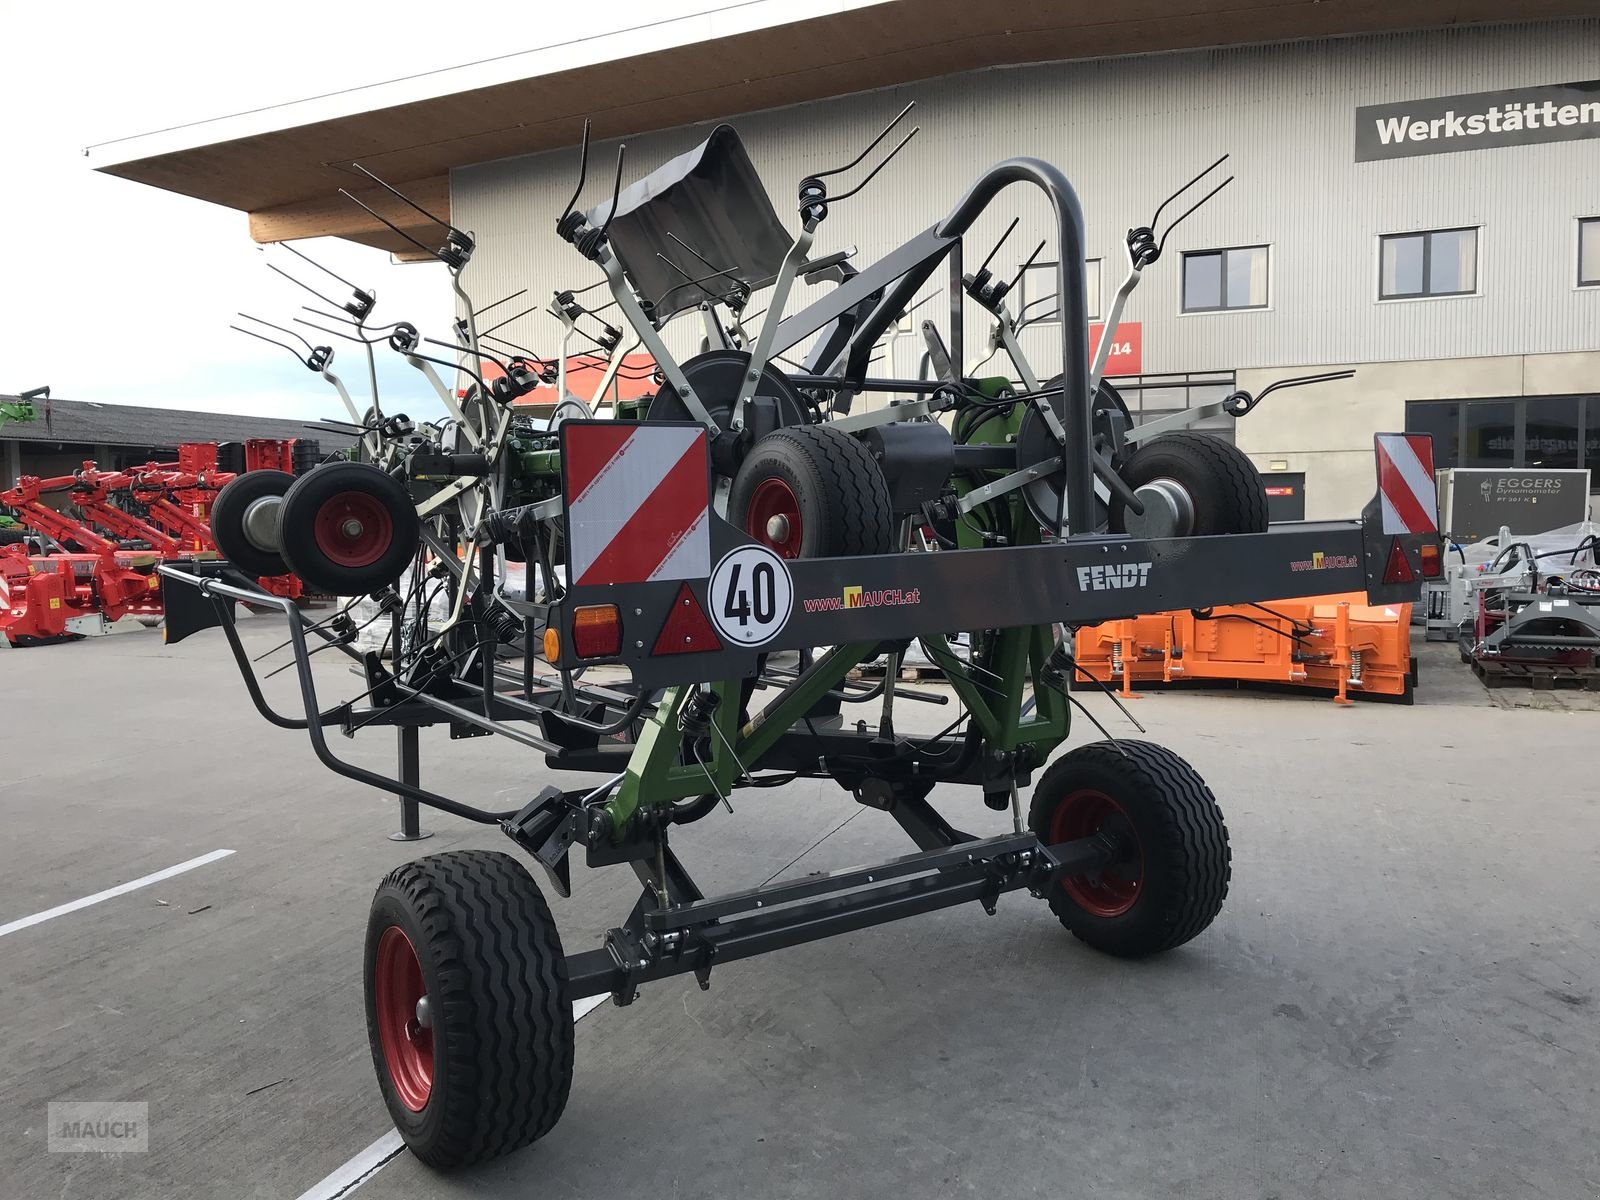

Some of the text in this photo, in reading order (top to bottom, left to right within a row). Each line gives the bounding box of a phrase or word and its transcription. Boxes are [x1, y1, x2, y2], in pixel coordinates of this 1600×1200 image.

[1375, 101, 1600, 144] Werkstätten
[1497, 478, 1562, 489] EGGERS
[1076, 562, 1152, 591] FENDT
[724, 562, 776, 626] 40
[804, 587, 920, 612] www.MAUCH.at
